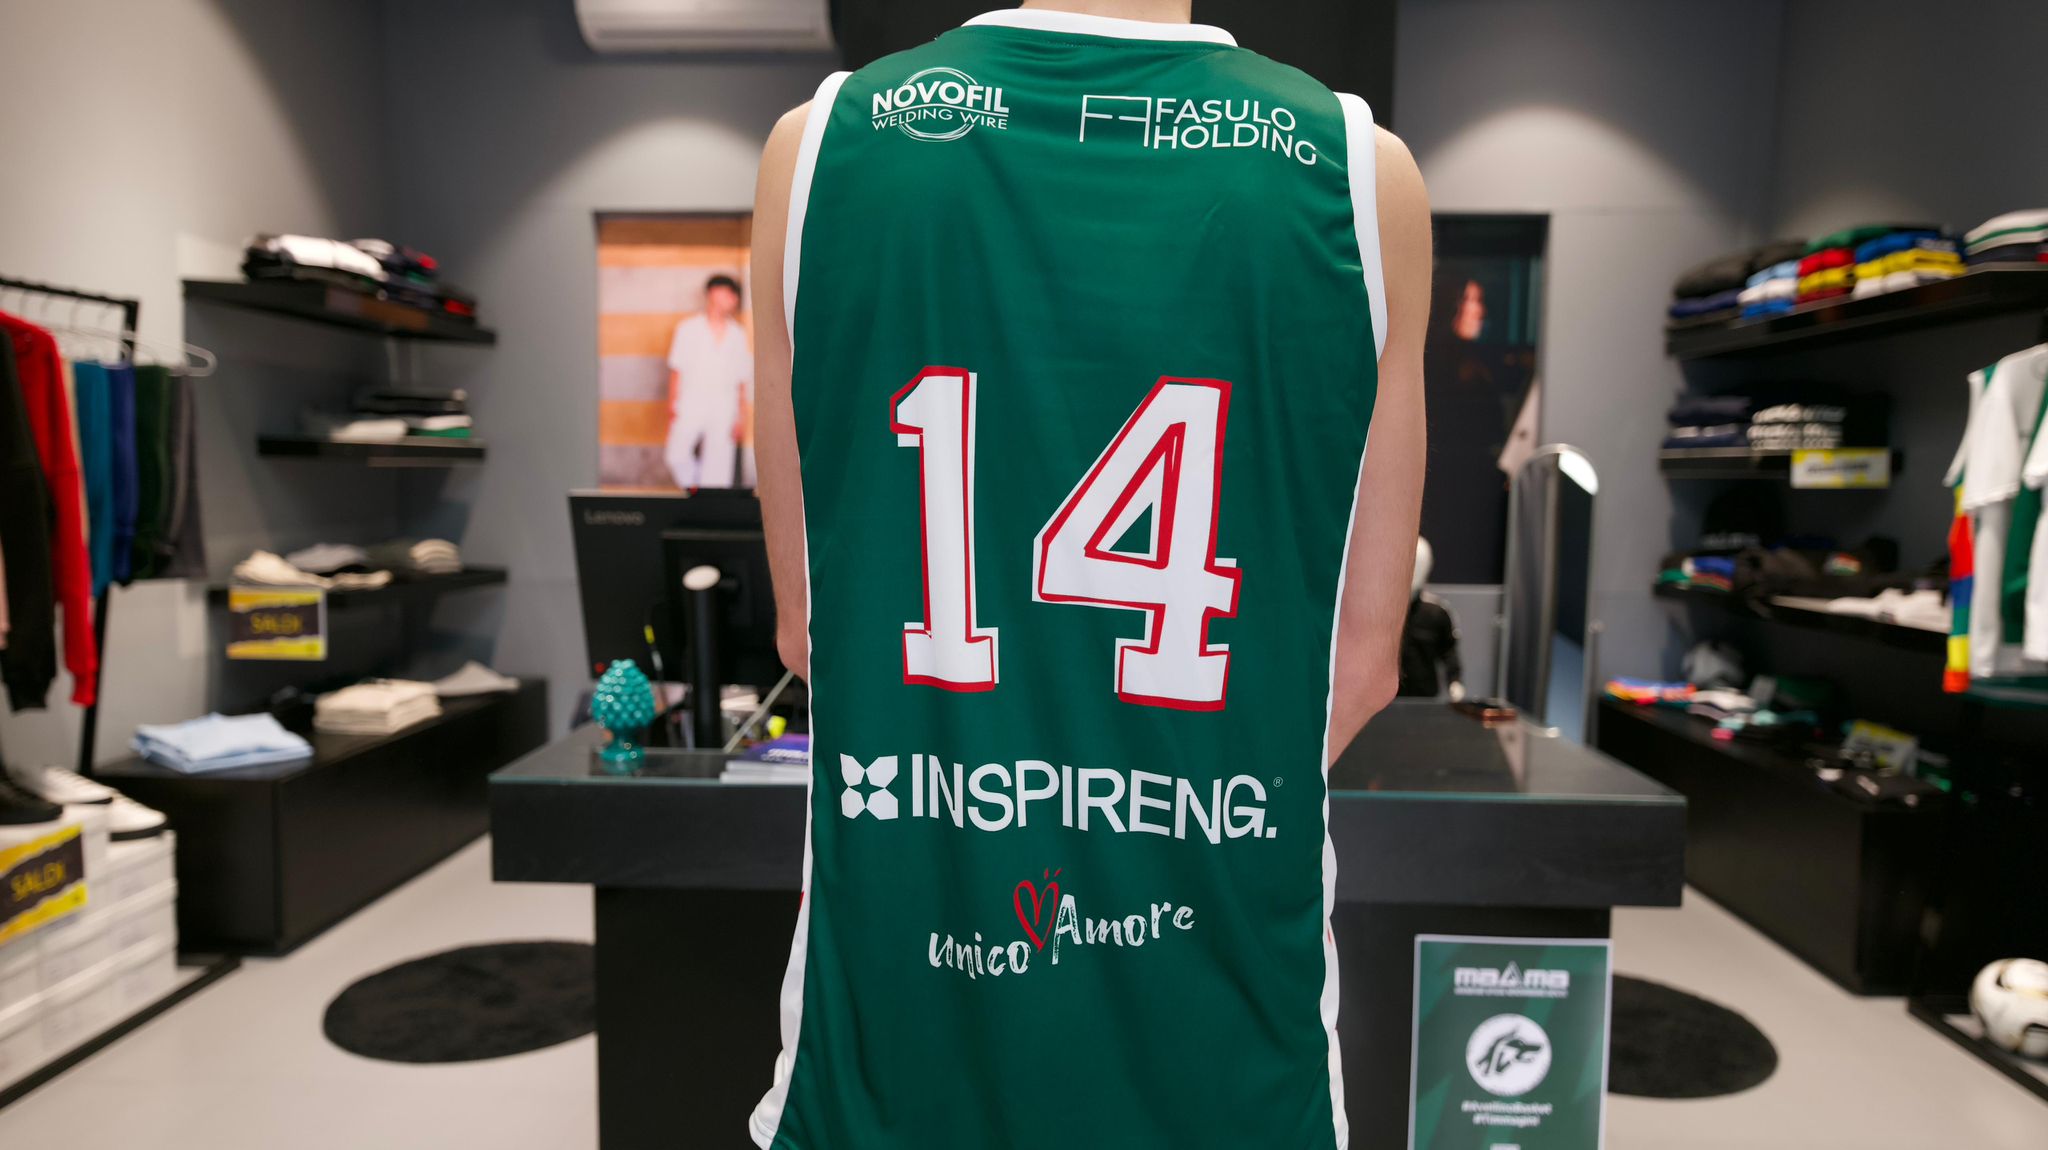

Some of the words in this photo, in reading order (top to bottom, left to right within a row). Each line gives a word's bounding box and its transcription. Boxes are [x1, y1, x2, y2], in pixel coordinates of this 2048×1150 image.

[872, 81, 1009, 114] NOVOFIL
[872, 107, 953, 132] WELDING
[960, 111, 1008, 131] WIRE
[1154, 98, 1296, 132] FASULO
[1153, 122, 1318, 166] HOLDING
[584, 507, 645, 526] Lenovo
[889, 364, 1243, 712] 14
[1051, 893, 1196, 965] Amore
